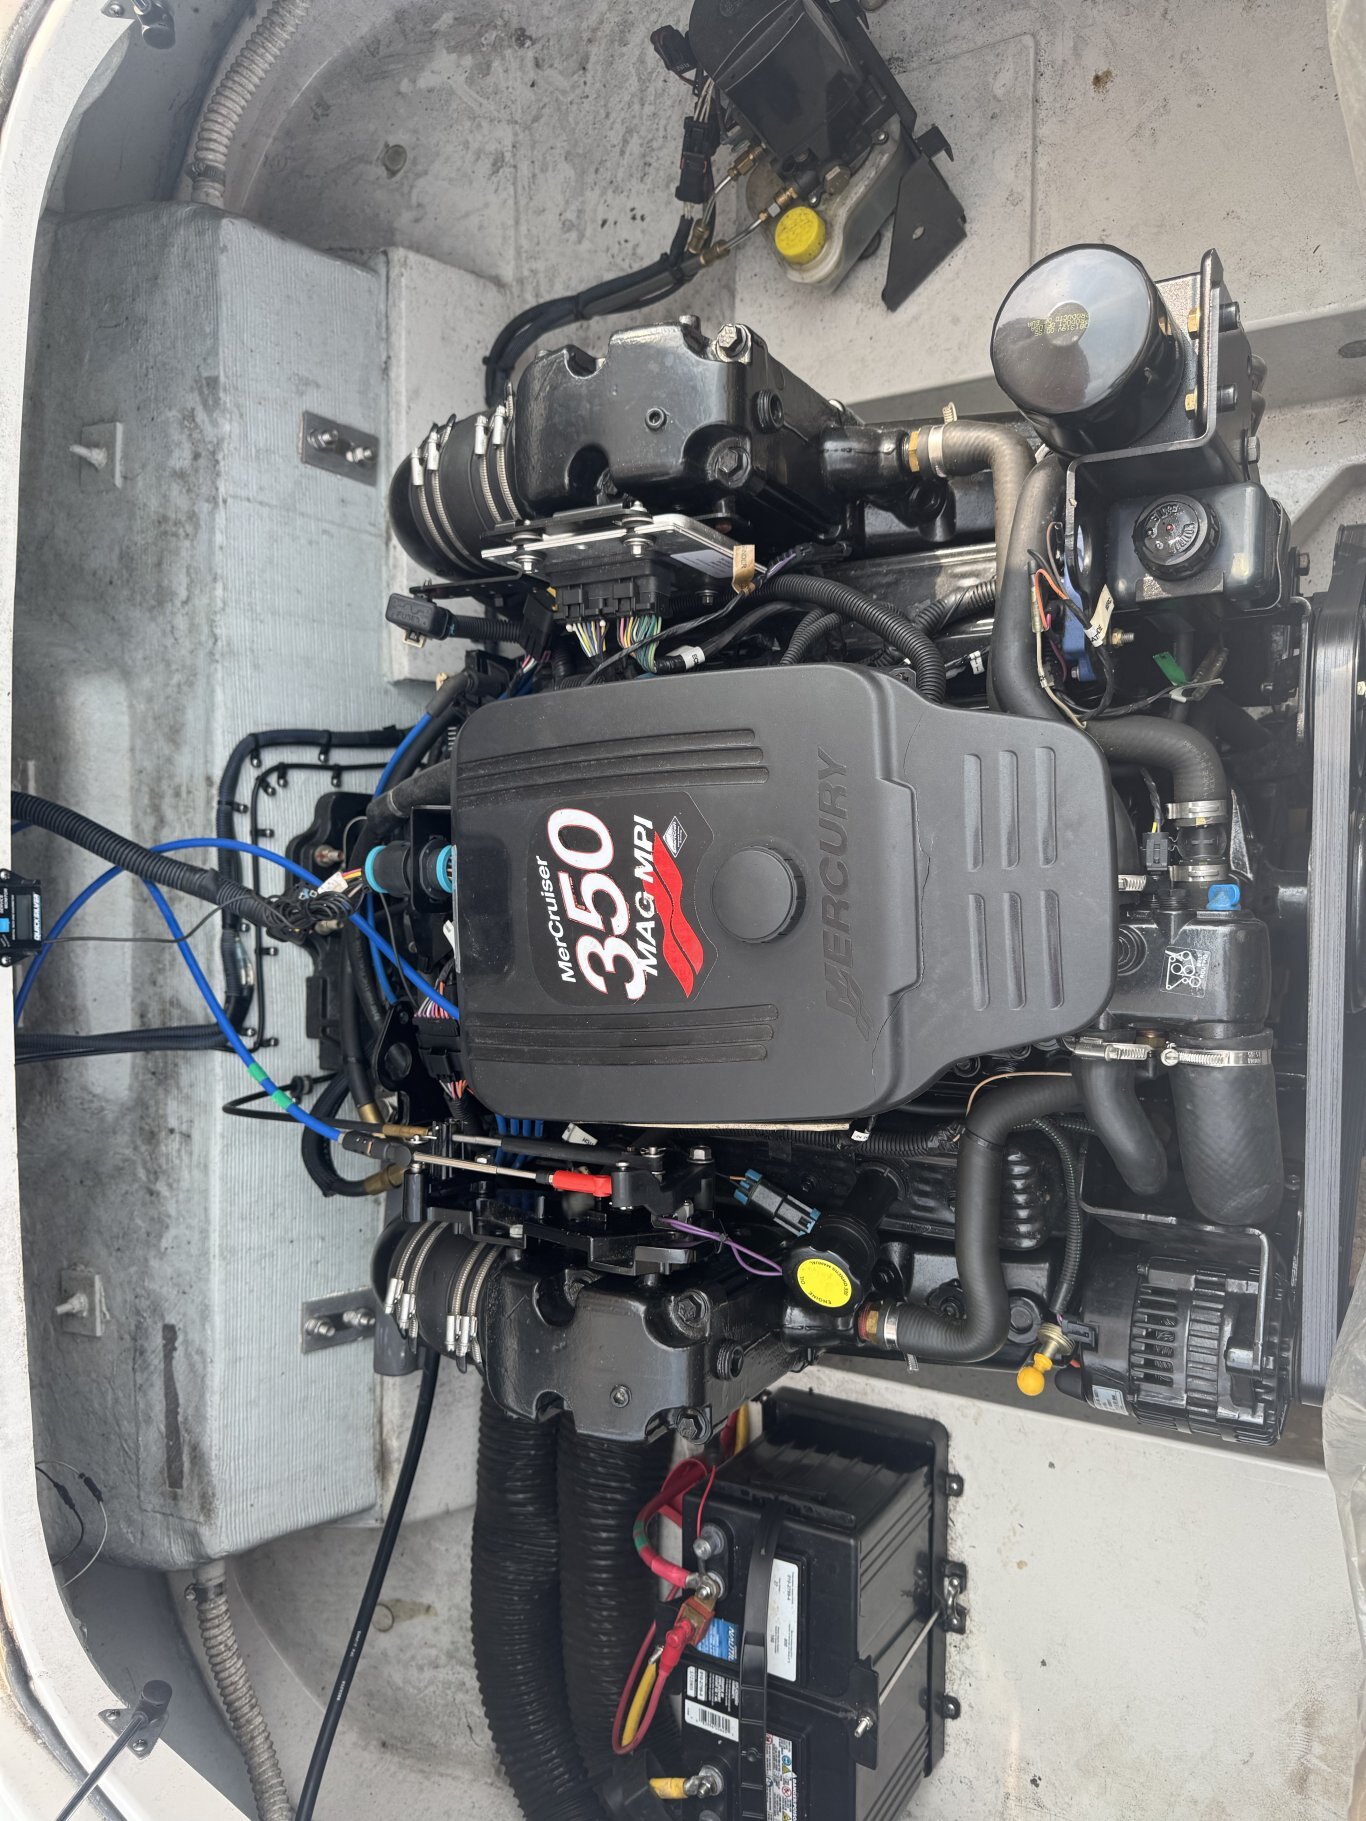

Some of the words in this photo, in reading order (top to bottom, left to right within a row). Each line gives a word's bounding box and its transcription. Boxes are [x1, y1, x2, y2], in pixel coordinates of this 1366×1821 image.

[634, 815, 654, 884] MPI
[817, 746, 860, 1021] MERCURY
[33, 892, 41, 941] QUICKSILVER
[536, 856, 576, 982] MerCruiser
[547, 808, 646, 1000] 350
[635, 890, 657, 976] MAG
[808, 1291, 832, 1304] ENGINE
